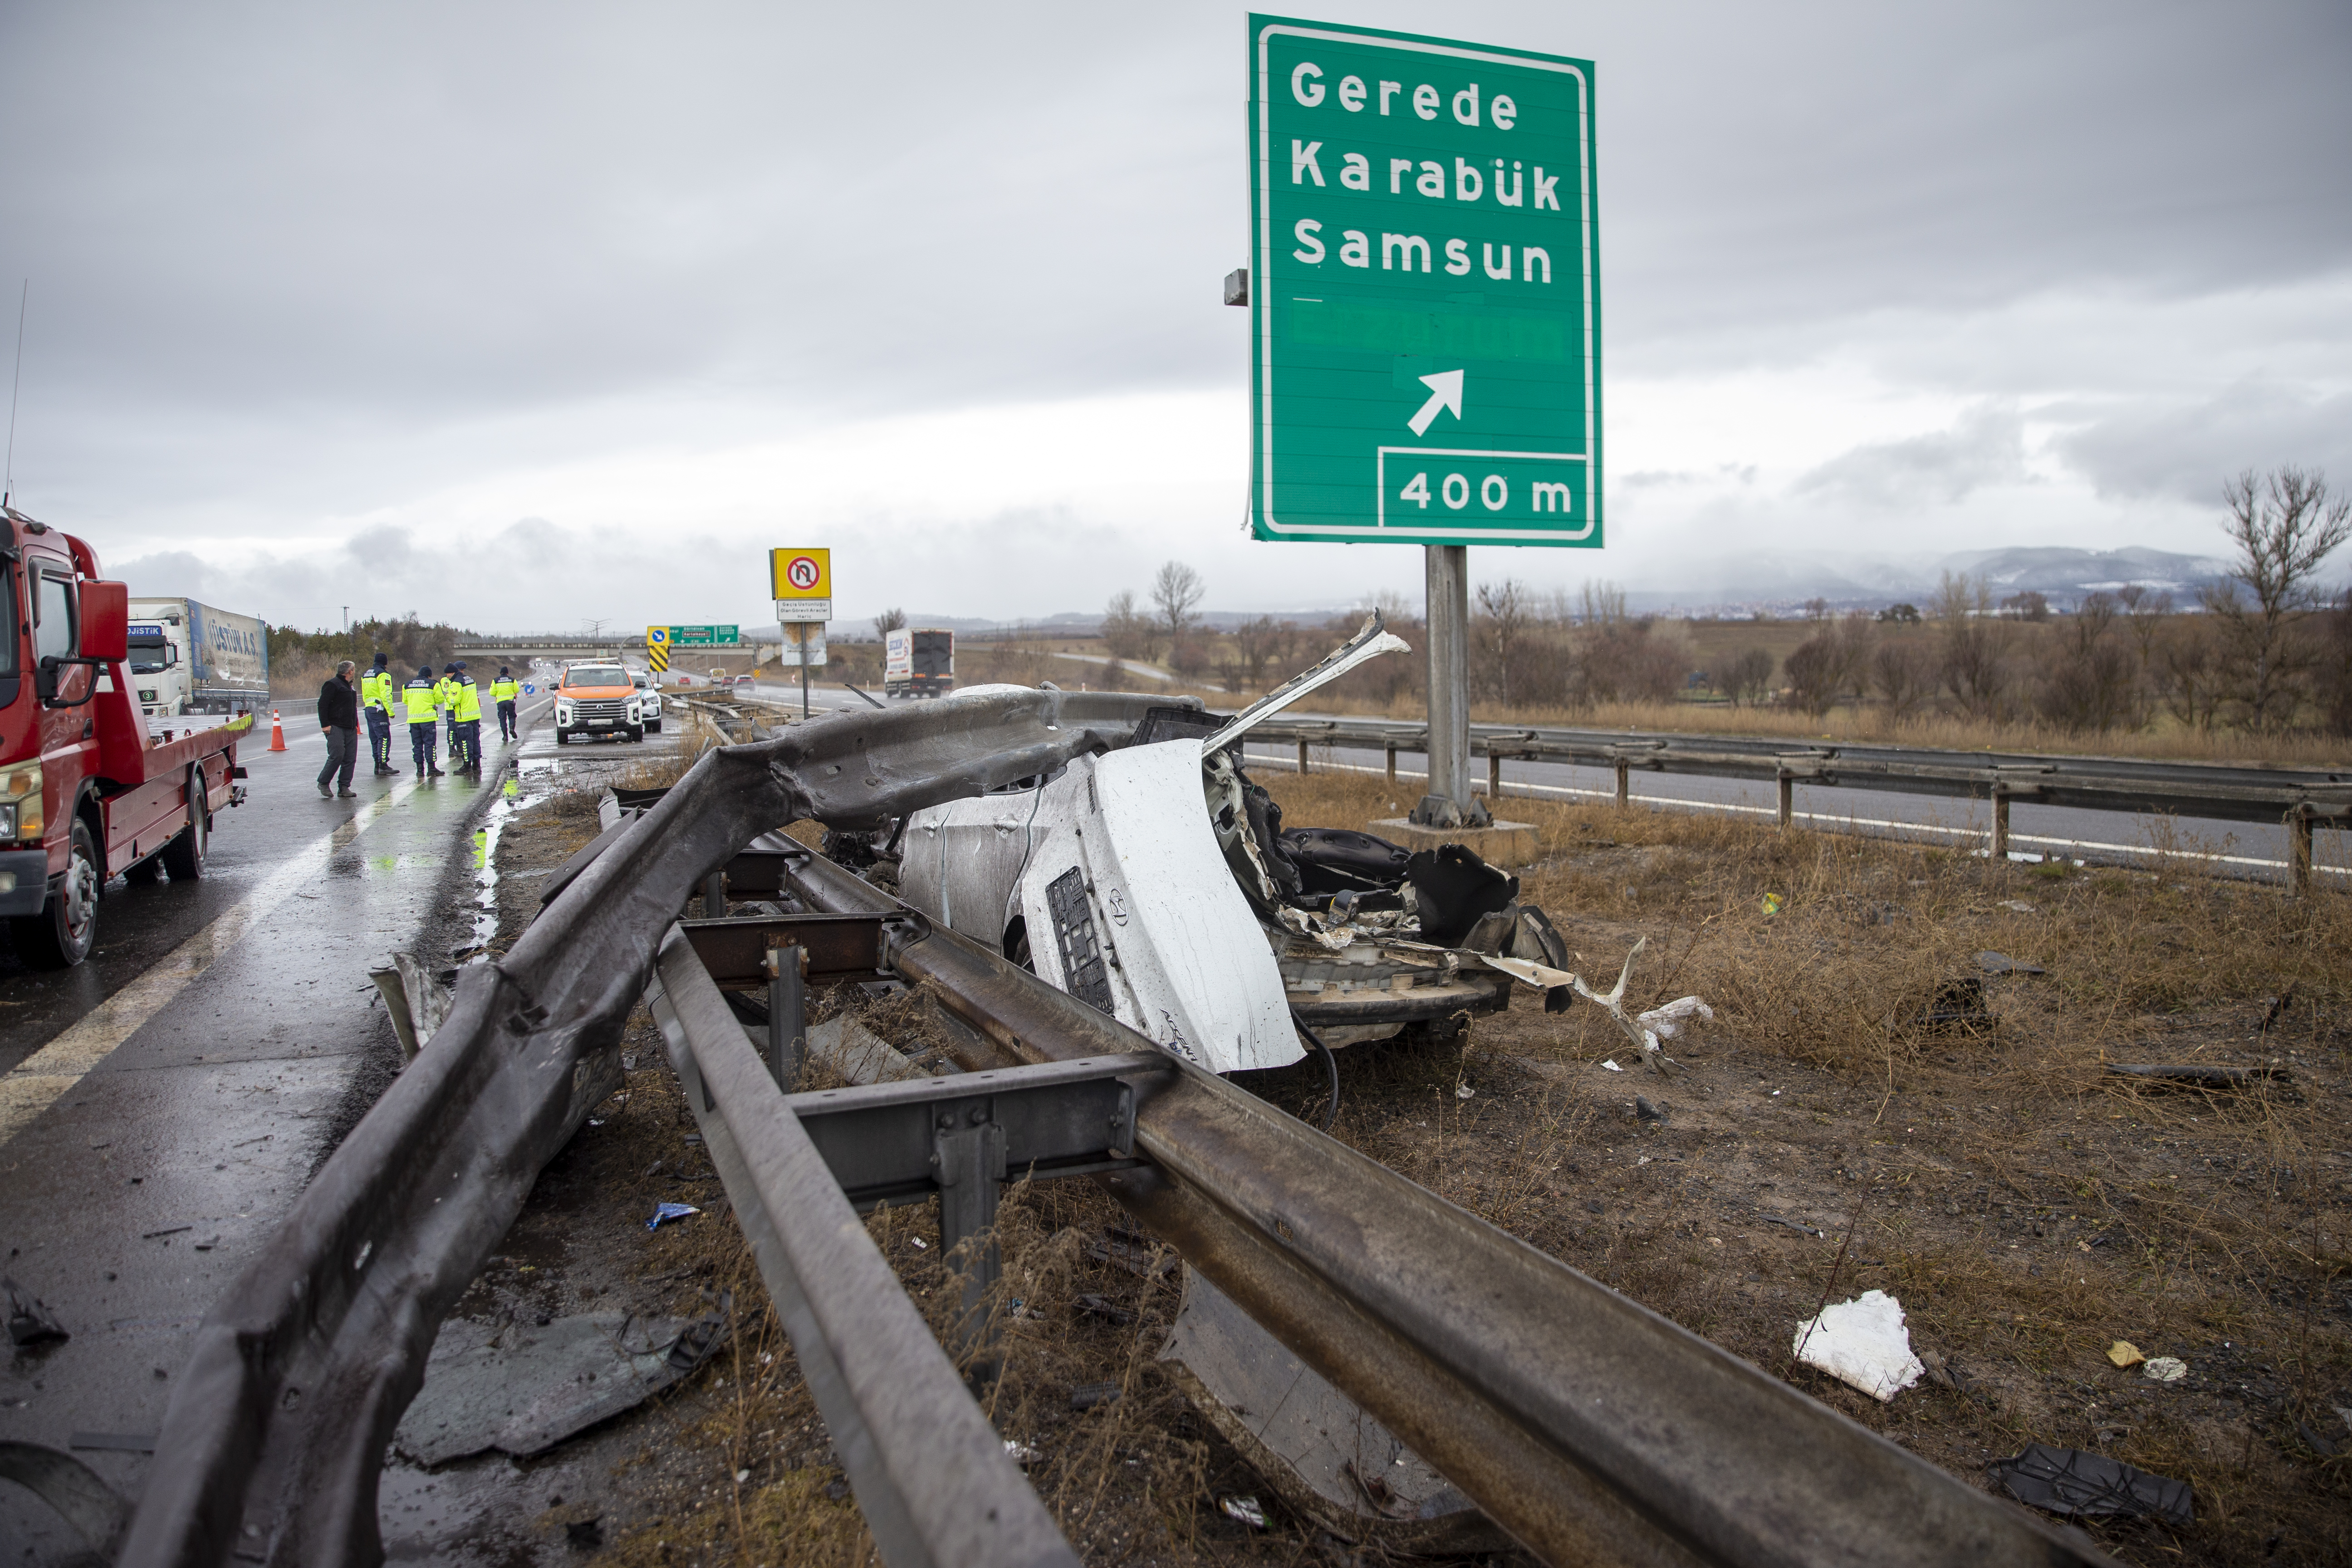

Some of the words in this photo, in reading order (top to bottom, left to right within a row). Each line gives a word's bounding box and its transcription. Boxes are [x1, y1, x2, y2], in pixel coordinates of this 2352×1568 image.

[1292, 63, 1516, 130] Gerede
[1292, 140, 1560, 211] Karabük
[1293, 219, 1551, 283] Samsun
[1400, 473, 1508, 510] 400
[1533, 482, 1571, 512] m
